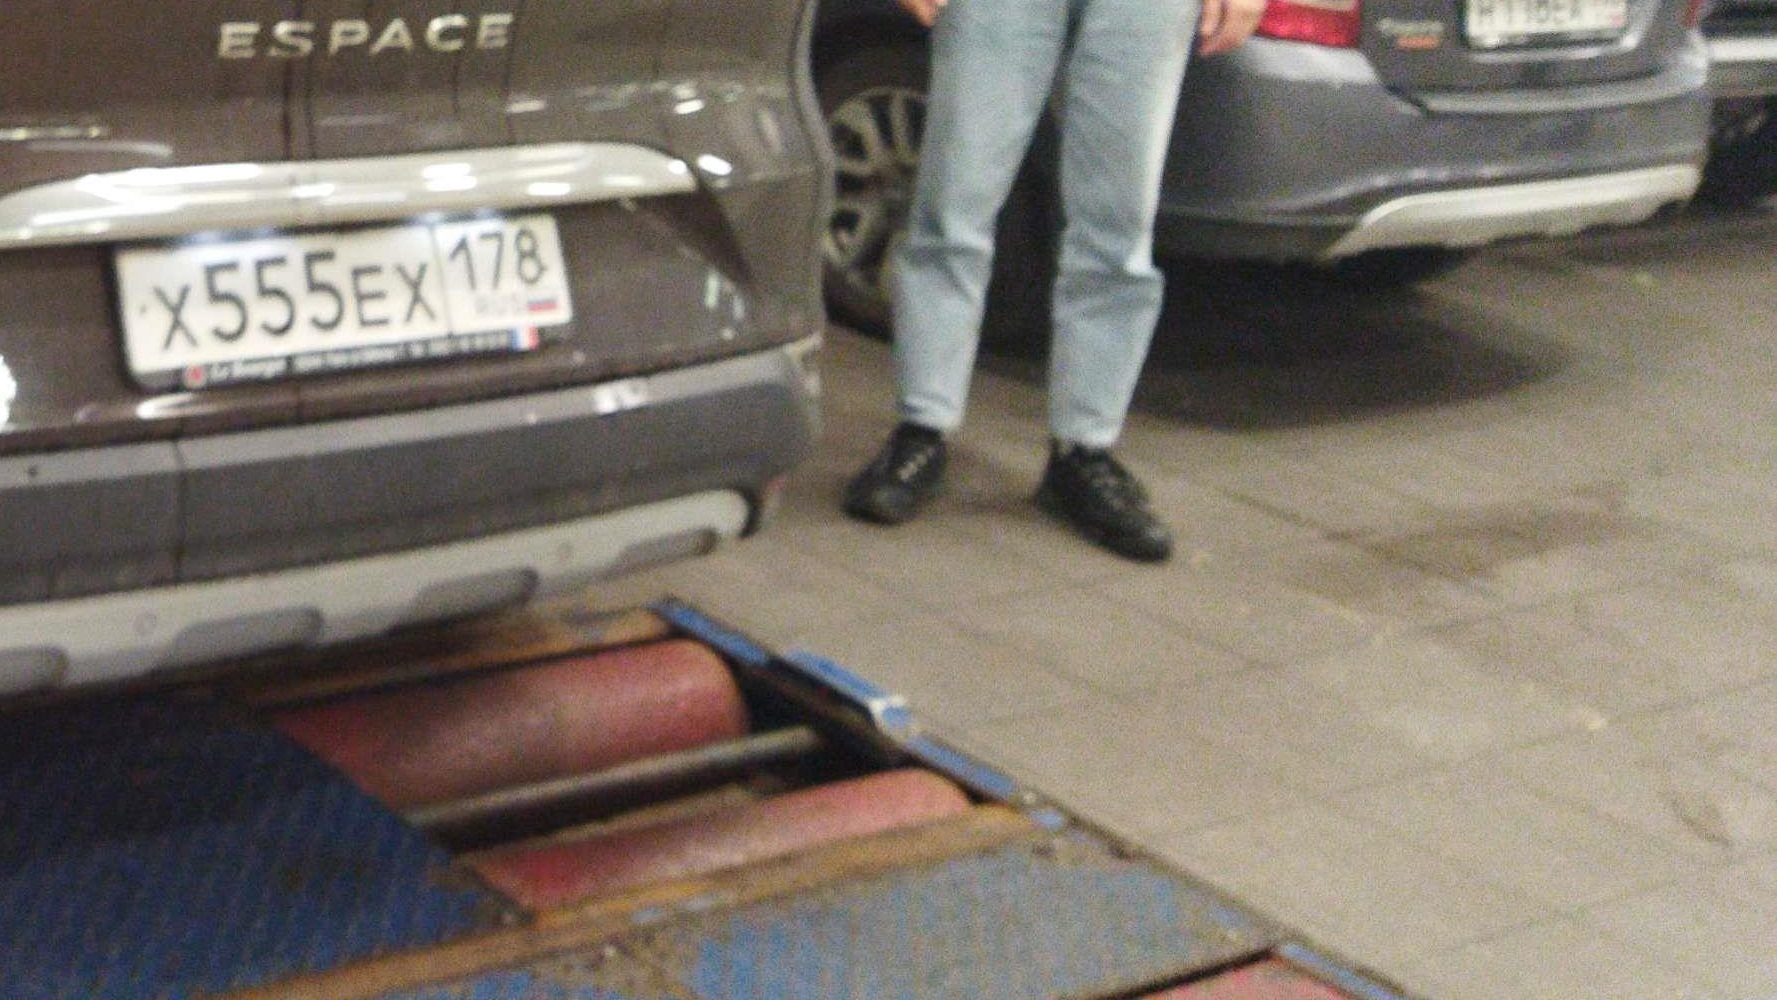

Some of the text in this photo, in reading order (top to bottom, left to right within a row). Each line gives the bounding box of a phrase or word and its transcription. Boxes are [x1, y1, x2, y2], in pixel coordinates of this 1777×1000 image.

[218, 12, 514, 58] ESPACE
[153, 228, 548, 351] X555EX 178
